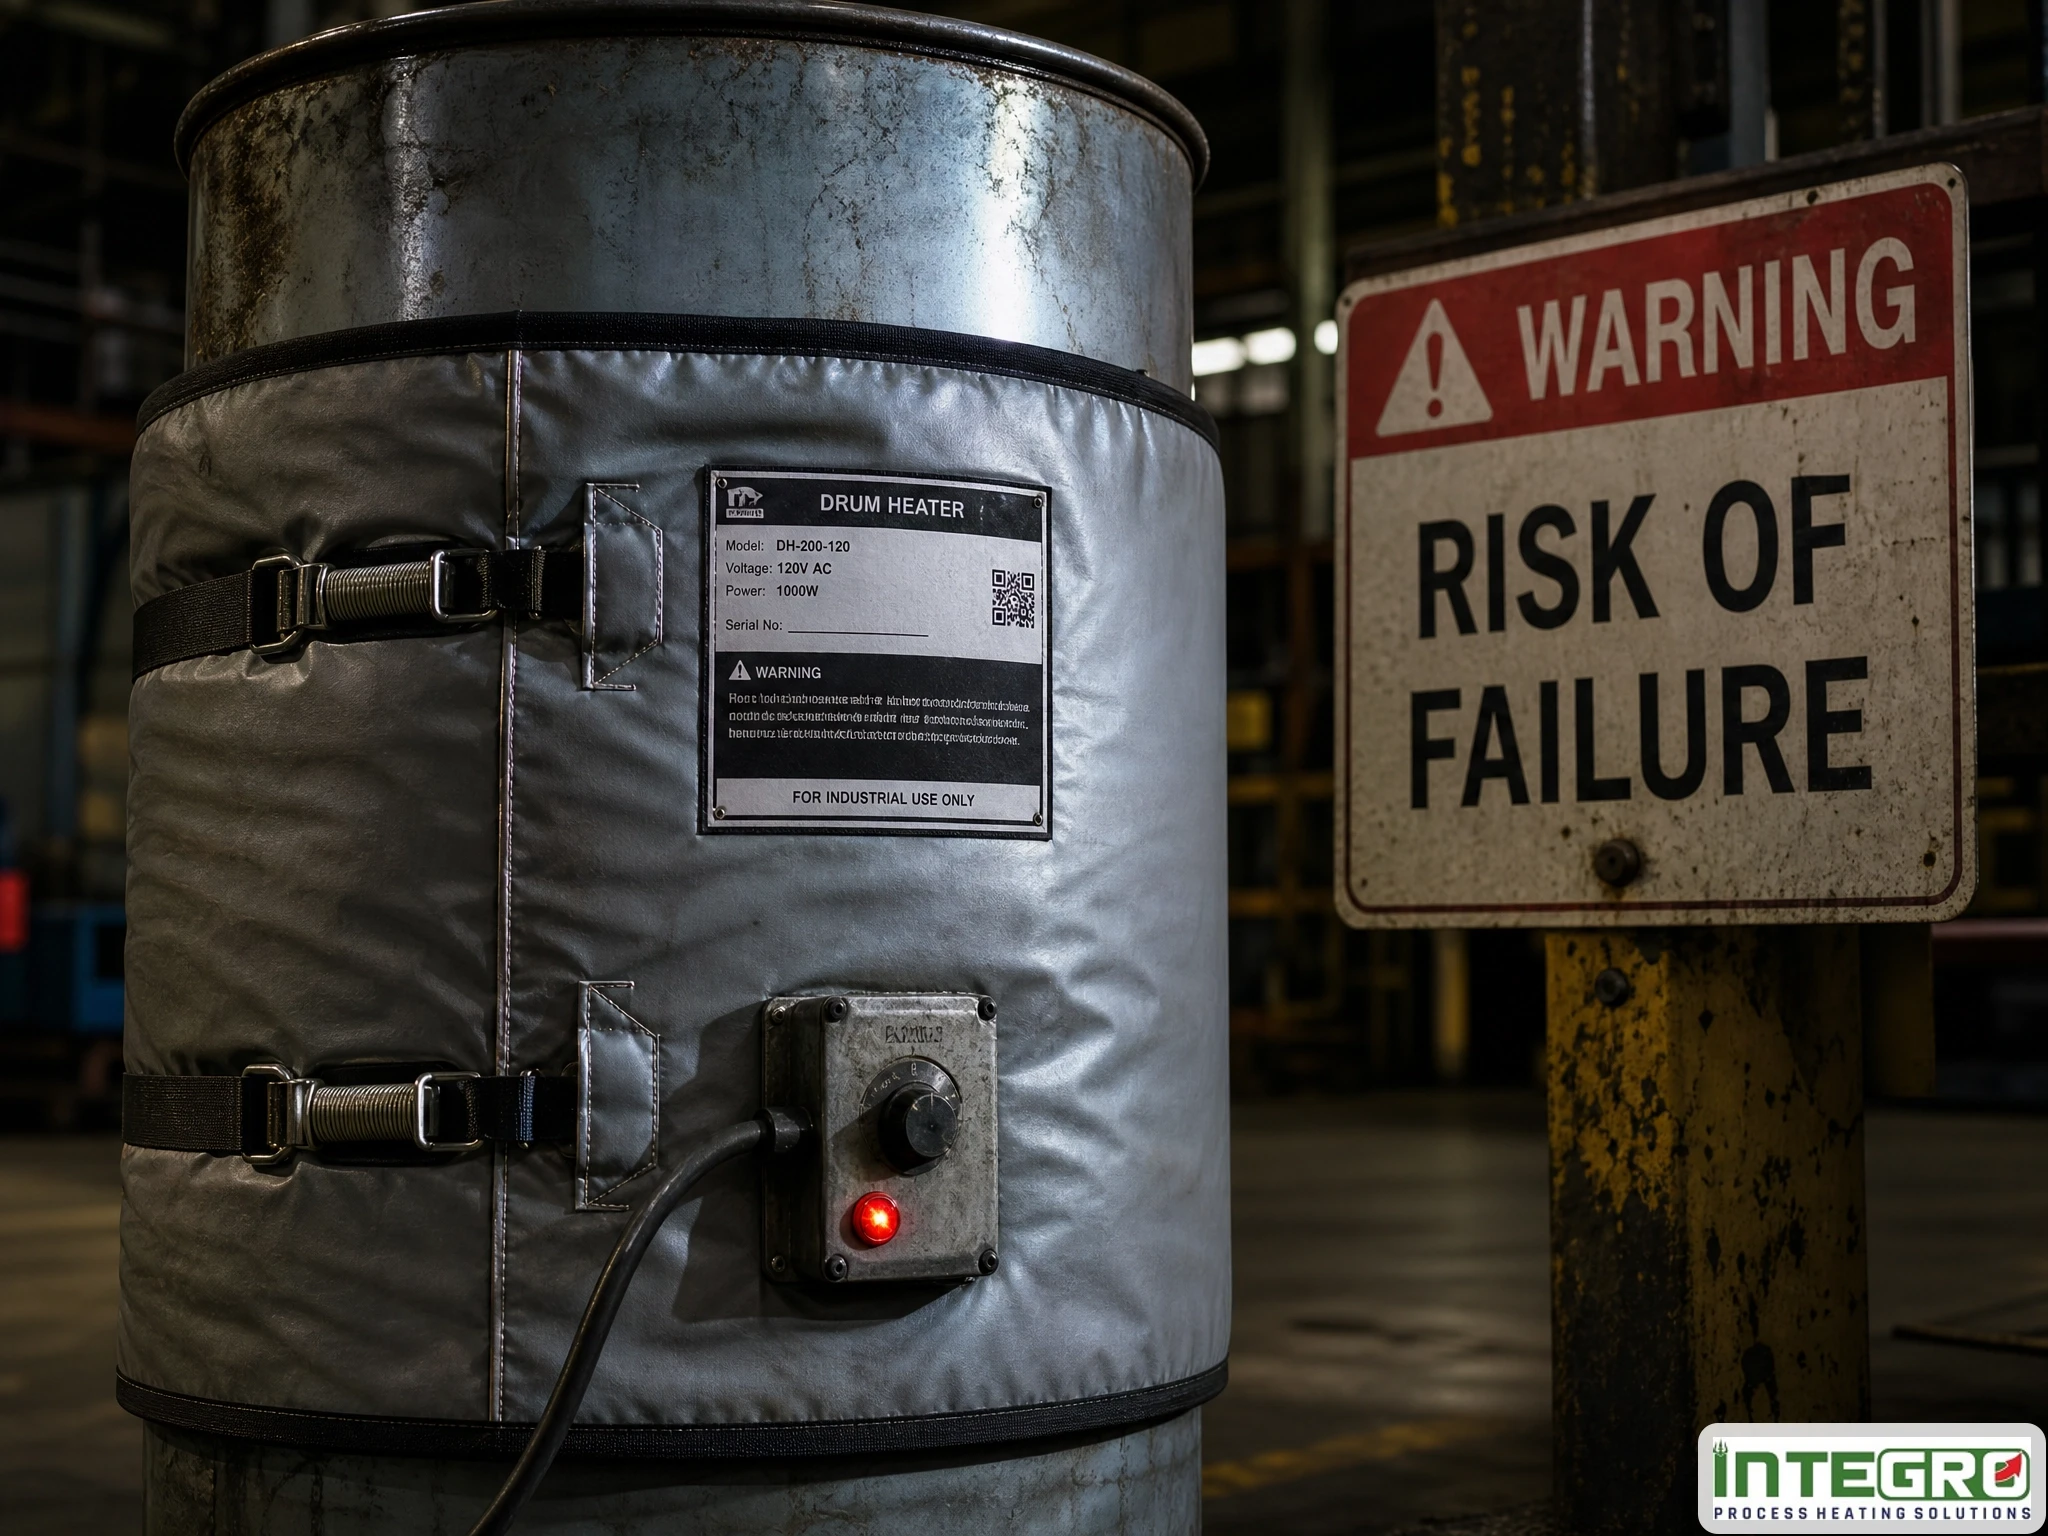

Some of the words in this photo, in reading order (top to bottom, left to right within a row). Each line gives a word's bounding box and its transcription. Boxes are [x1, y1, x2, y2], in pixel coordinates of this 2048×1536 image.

[1517, 236, 1917, 401] WARNING
[820, 493, 880, 513] DRUM
[888, 496, 965, 519] HEATER
[725, 540, 764, 552] Model:
[776, 539, 850, 553] DH-200-120
[1418, 493, 1661, 640] RISK
[1702, 473, 1852, 614] OF
[725, 562, 773, 576] Voltage:
[777, 562, 808, 575] 120V
[812, 562, 832, 575] AC
[725, 585, 766, 597] Power:
[776, 585, 819, 597] 1000W
[725, 618, 760, 631] Serial
[763, 619, 783, 631] No:
[755, 666, 822, 680] WARNING
[1410, 655, 1873, 810] FAILURE
[792, 791, 822, 804] FOR
[826, 791, 908, 805] INDUSTRIAL
[912, 793, 938, 806] USE
[942, 793, 975, 807] ONLY
